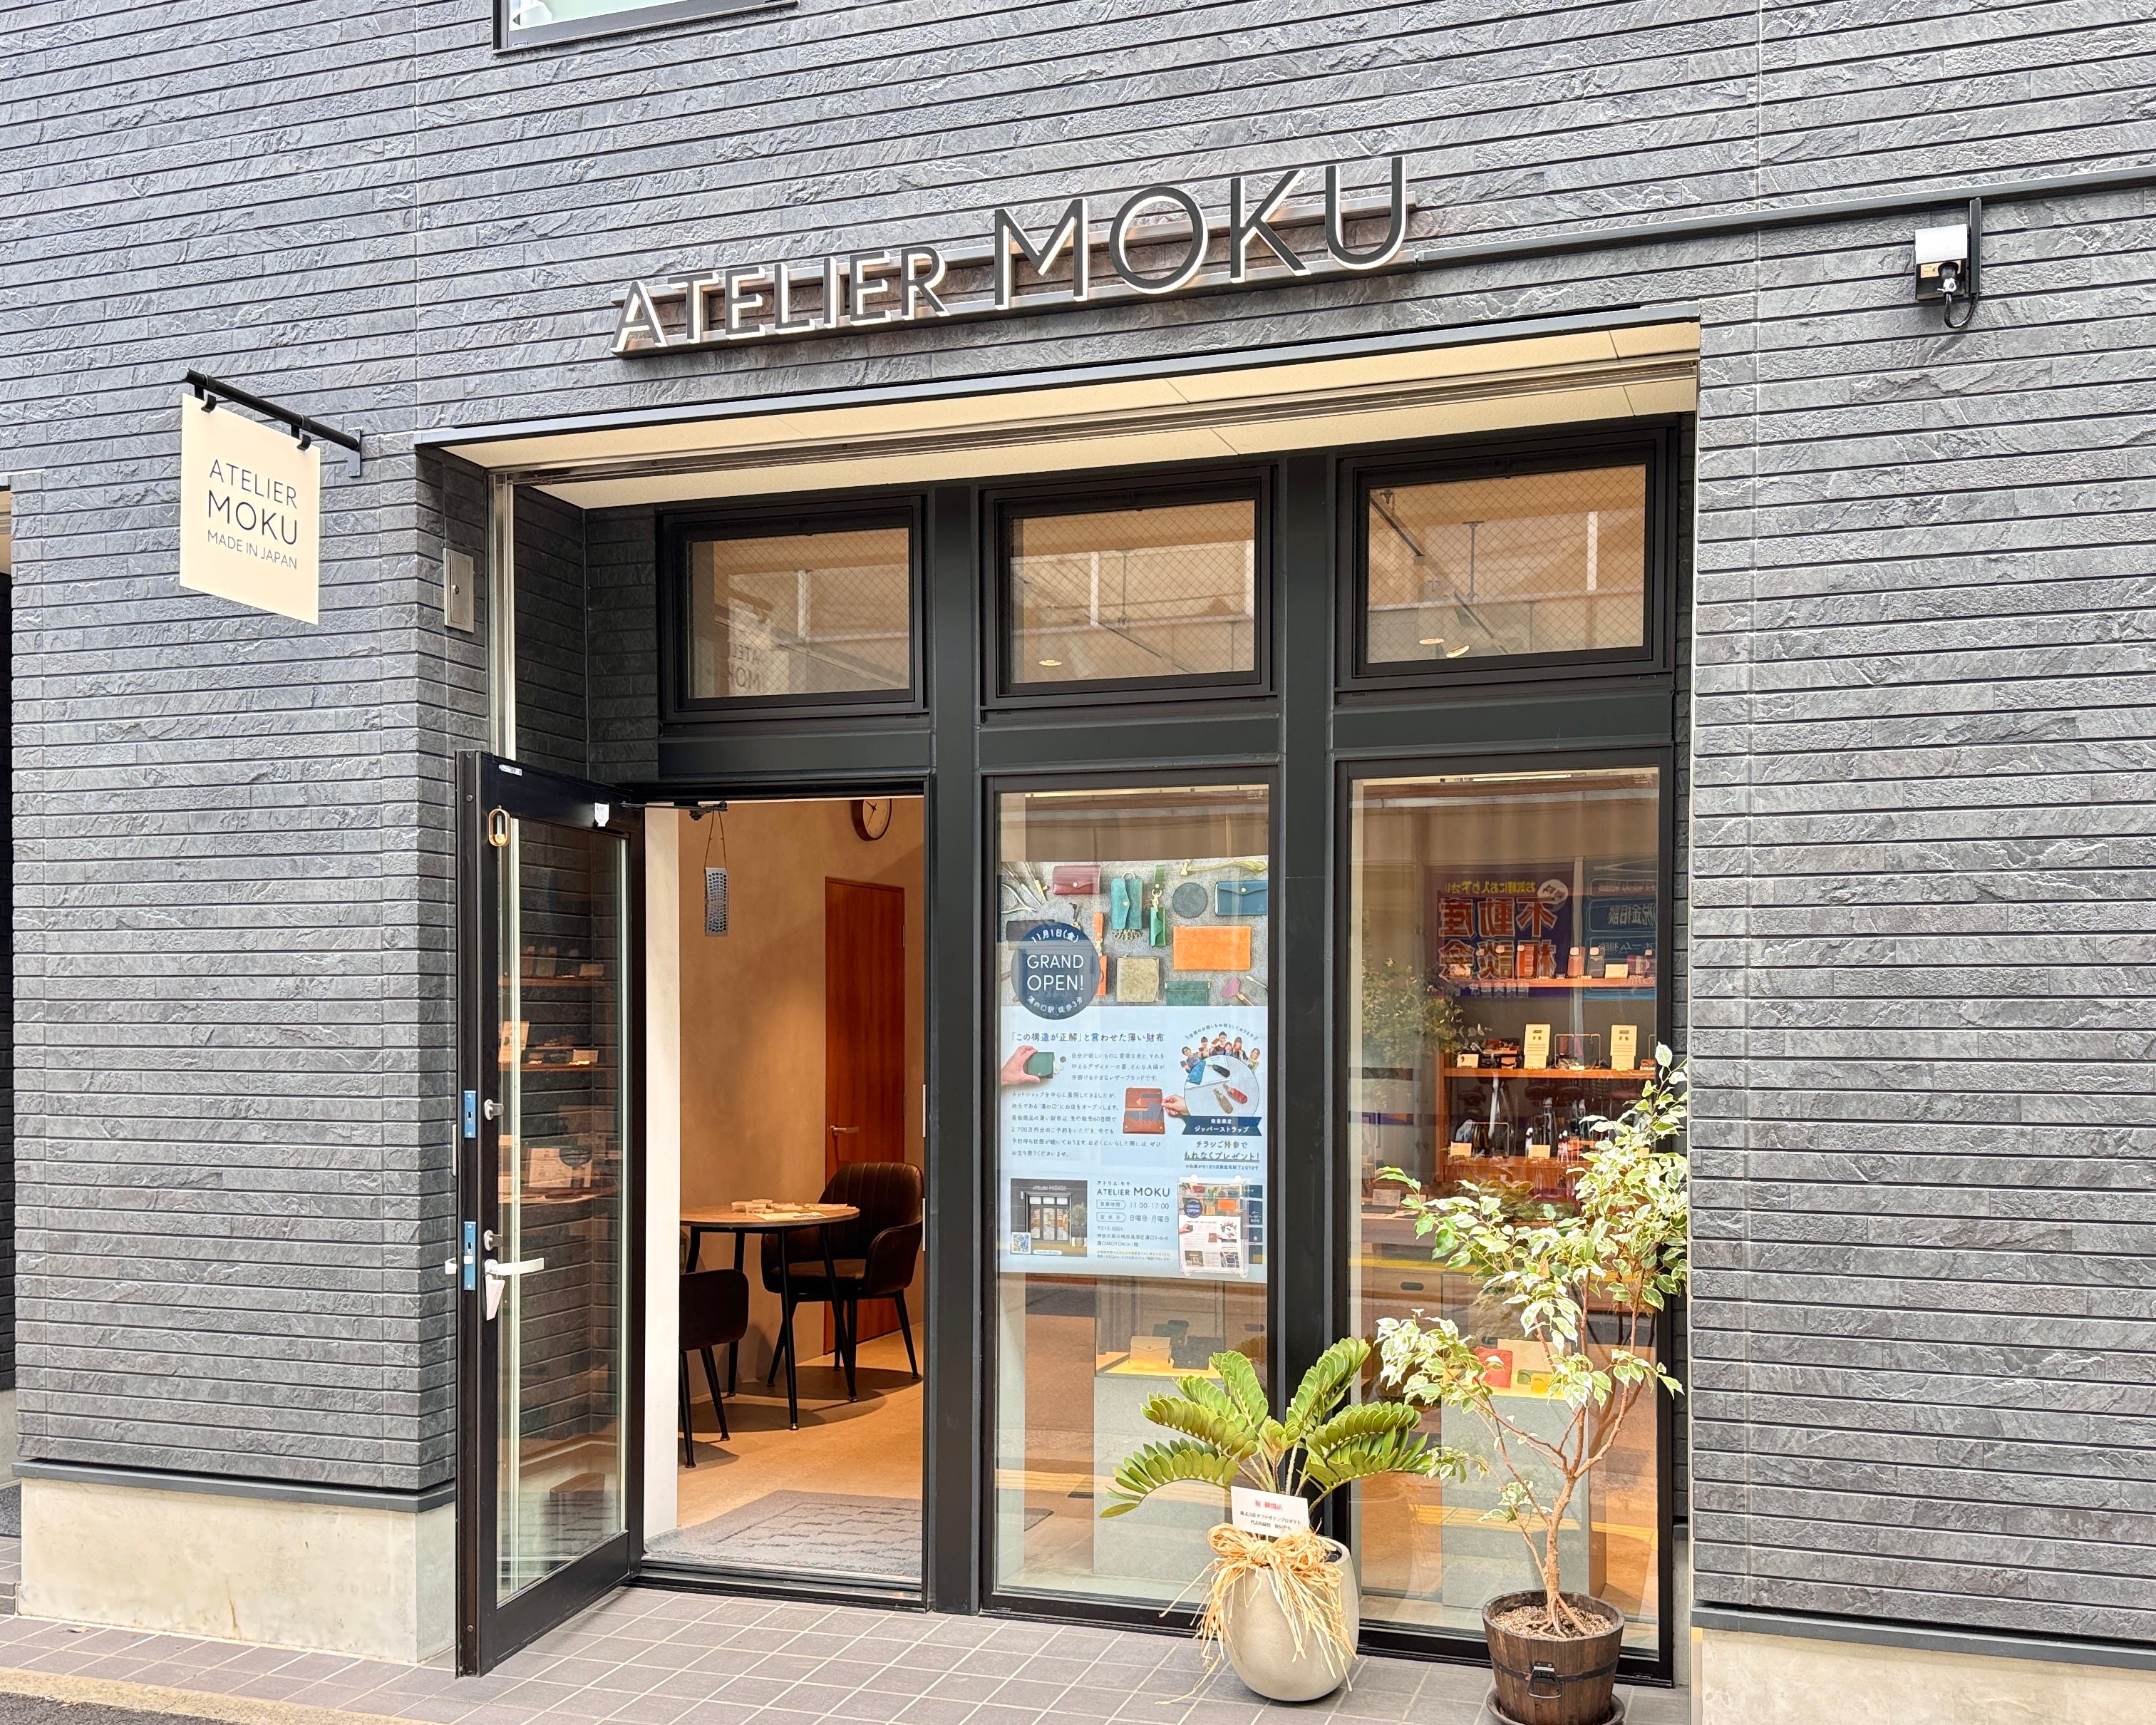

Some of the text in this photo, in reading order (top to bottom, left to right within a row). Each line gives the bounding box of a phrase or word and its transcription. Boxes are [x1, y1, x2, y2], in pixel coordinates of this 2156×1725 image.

[610, 156, 1406, 351] ATELIER MOKU
[210, 459, 298, 509] ATELIER
[208, 490, 297, 545] MOKU
[207, 530, 297, 570] MADE IN JAPAN
[1027, 955, 1083, 969] GRAND
[1027, 975, 1083, 991] OPEN!
[1012, 1032, 1165, 1042] 「この構造が正解」と言わせた薄い財布
[1133, 1188, 1170, 1197] MOKU
